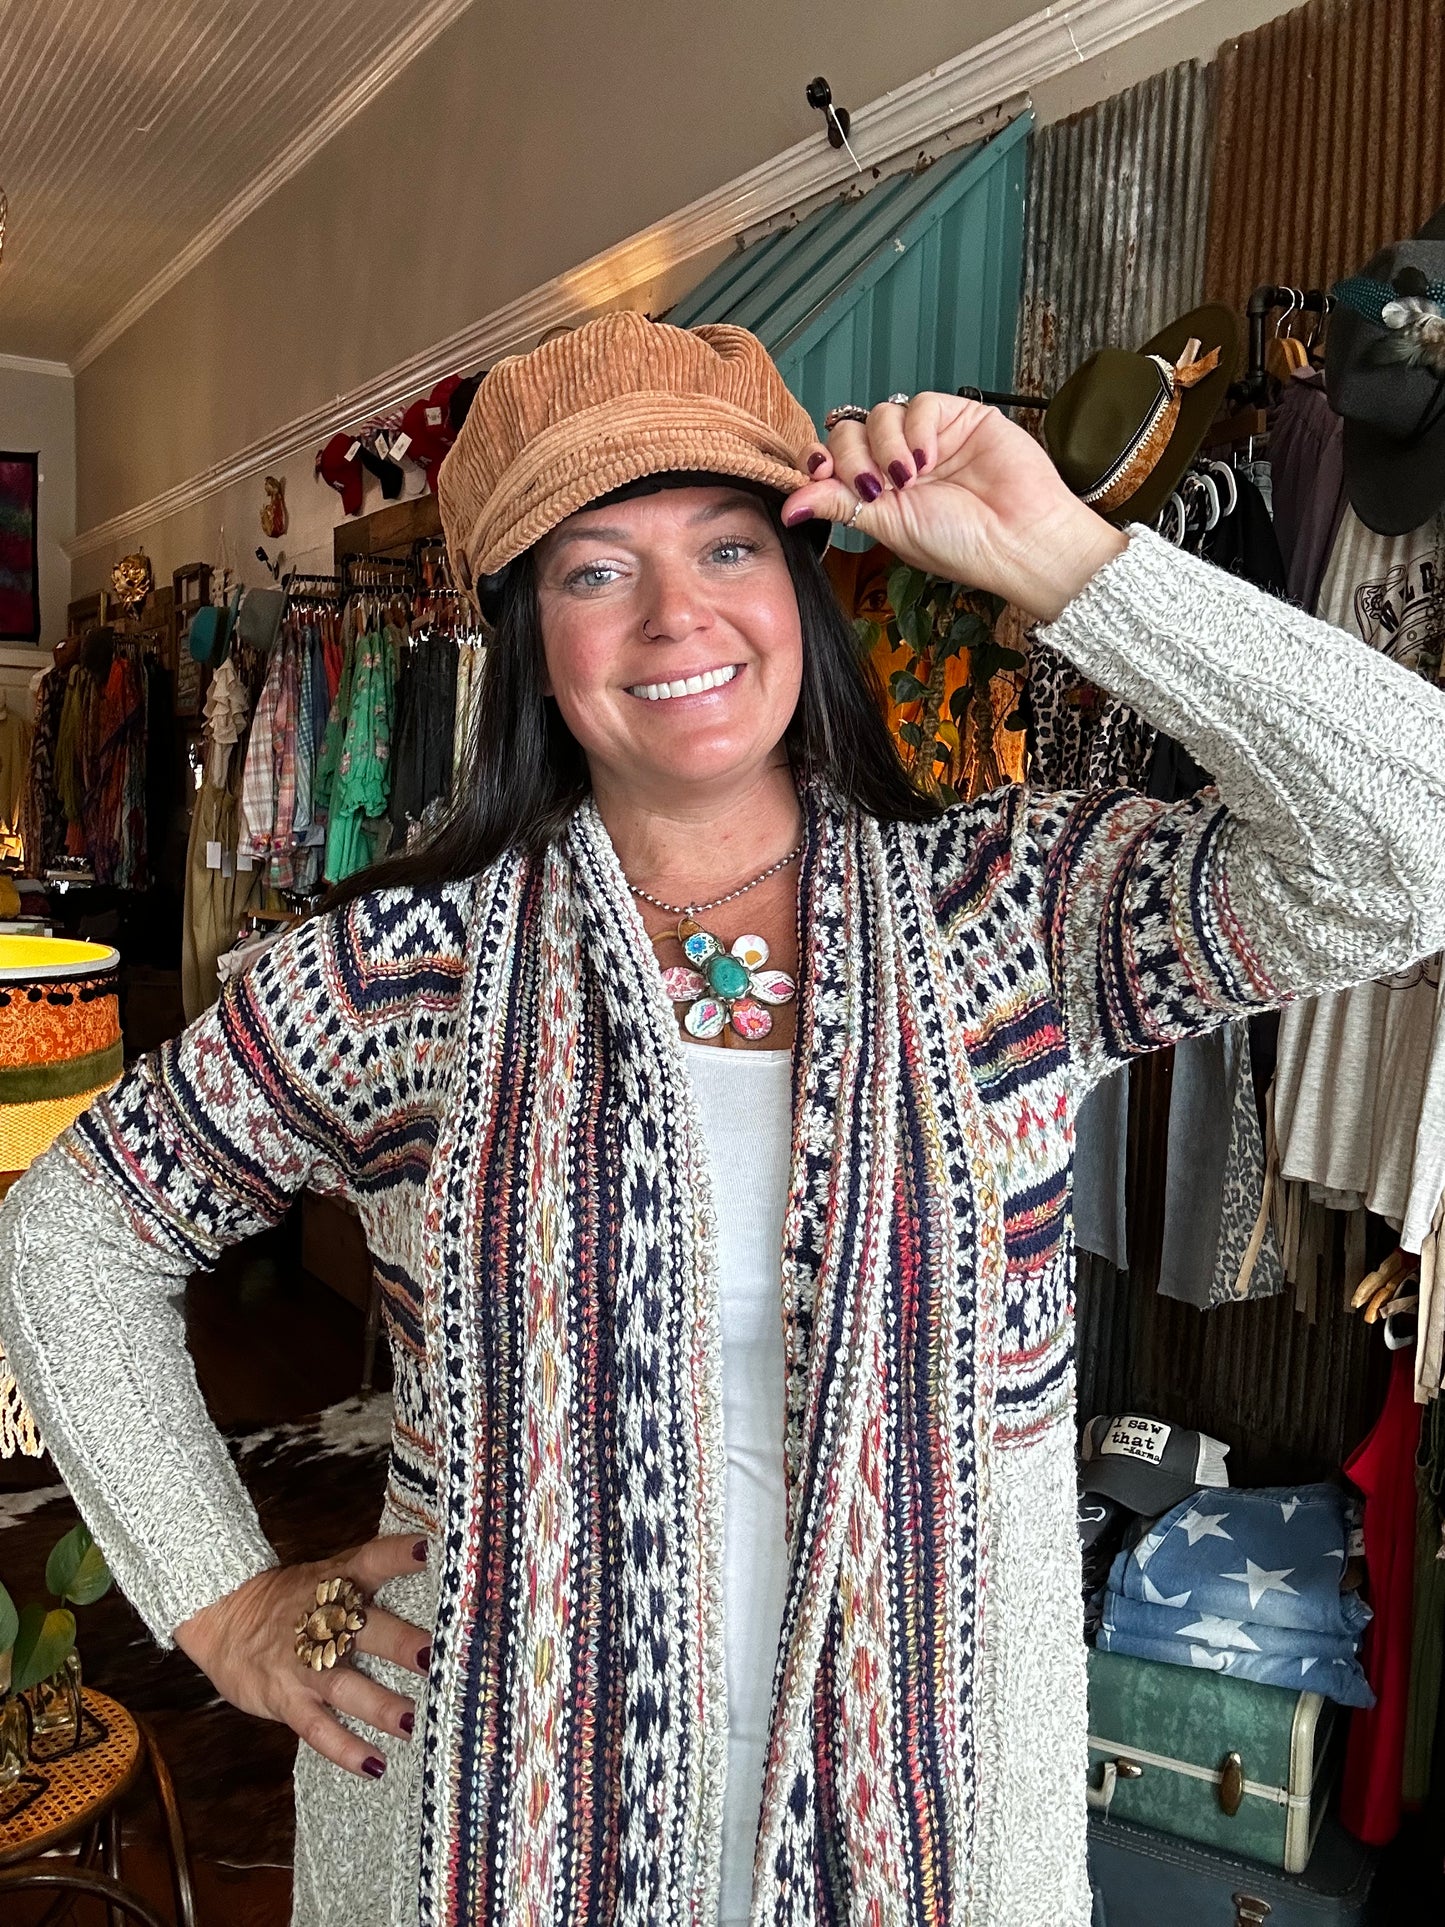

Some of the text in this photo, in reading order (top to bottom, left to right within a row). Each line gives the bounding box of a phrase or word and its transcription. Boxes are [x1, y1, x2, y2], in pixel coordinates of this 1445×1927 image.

[1114, 1417, 1163, 1434] I saw
[1112, 1431, 1155, 1450] that
